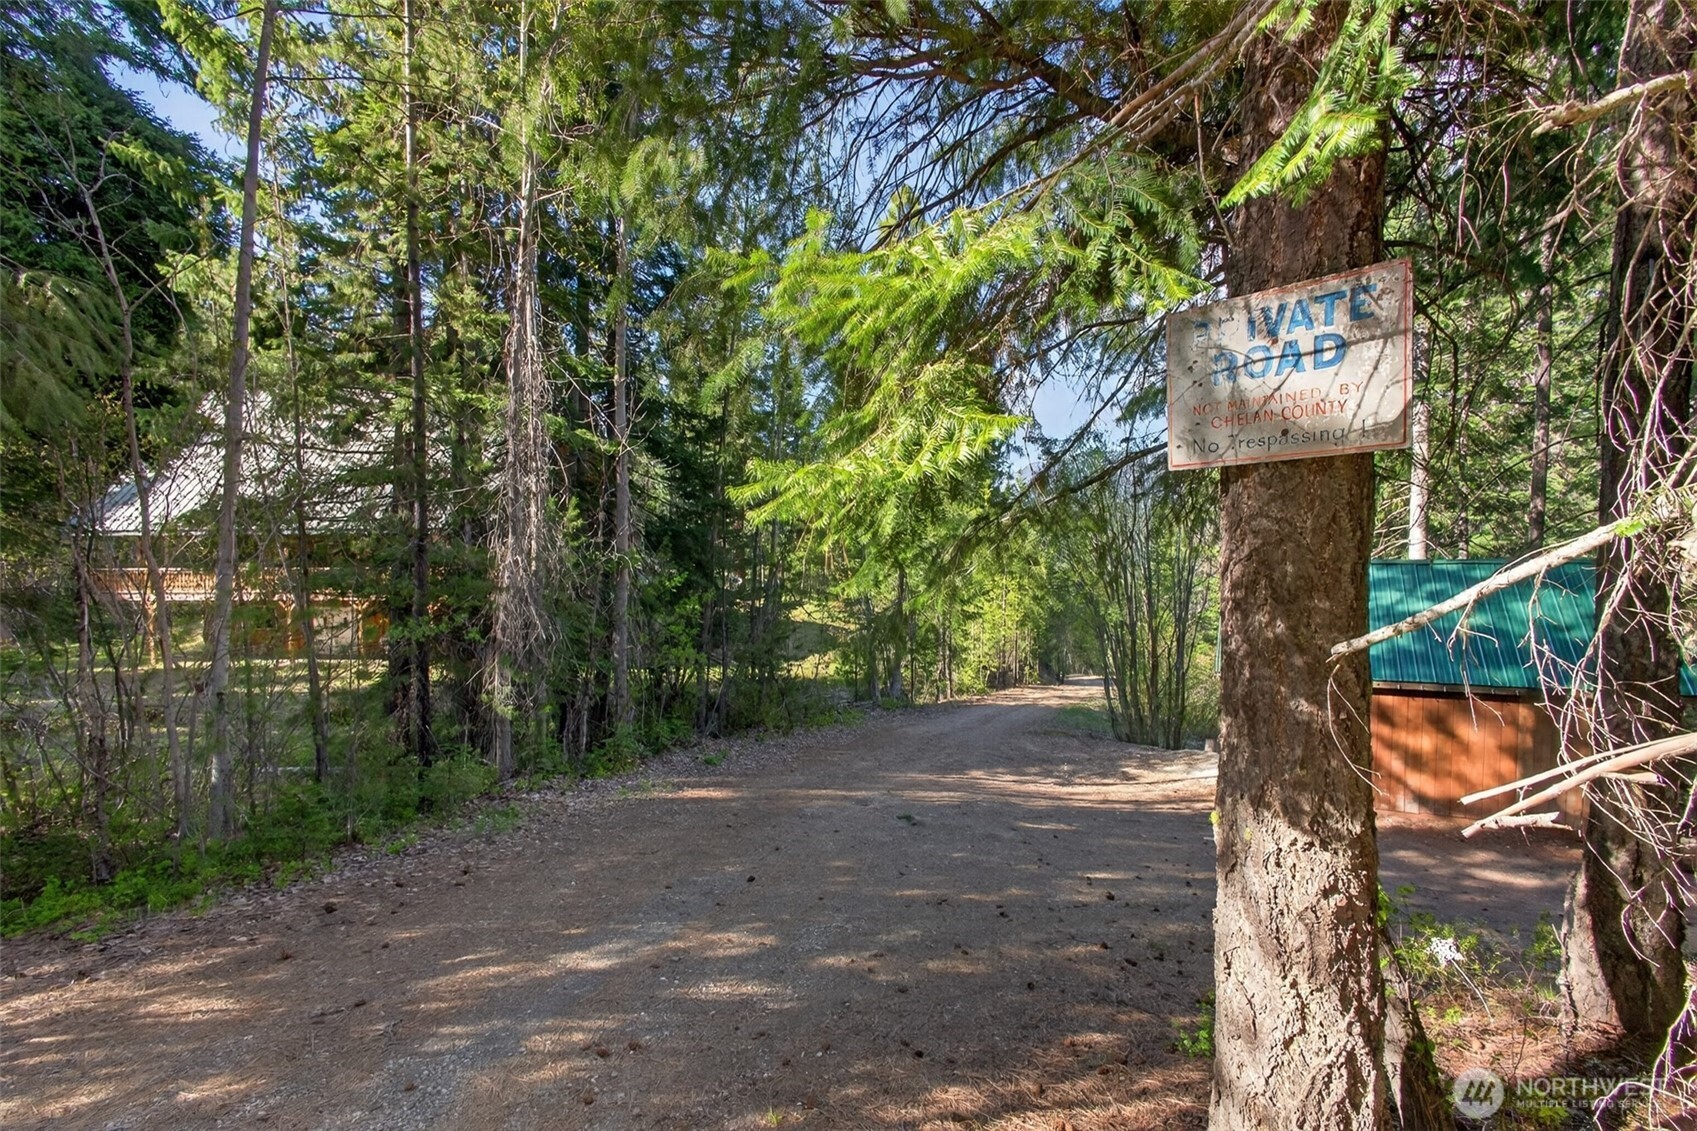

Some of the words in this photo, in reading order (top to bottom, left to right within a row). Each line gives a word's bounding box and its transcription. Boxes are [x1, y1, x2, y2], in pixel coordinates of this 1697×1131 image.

[1212, 333, 1347, 386] ROAD
[1193, 402, 1221, 416] NOT
[1340, 381, 1364, 395] BY
[1211, 409, 1274, 429] CHELAN
[1281, 399, 1348, 420] COUNTY
[1193, 438, 1220, 453] No
[1228, 428, 1345, 452] respassing
